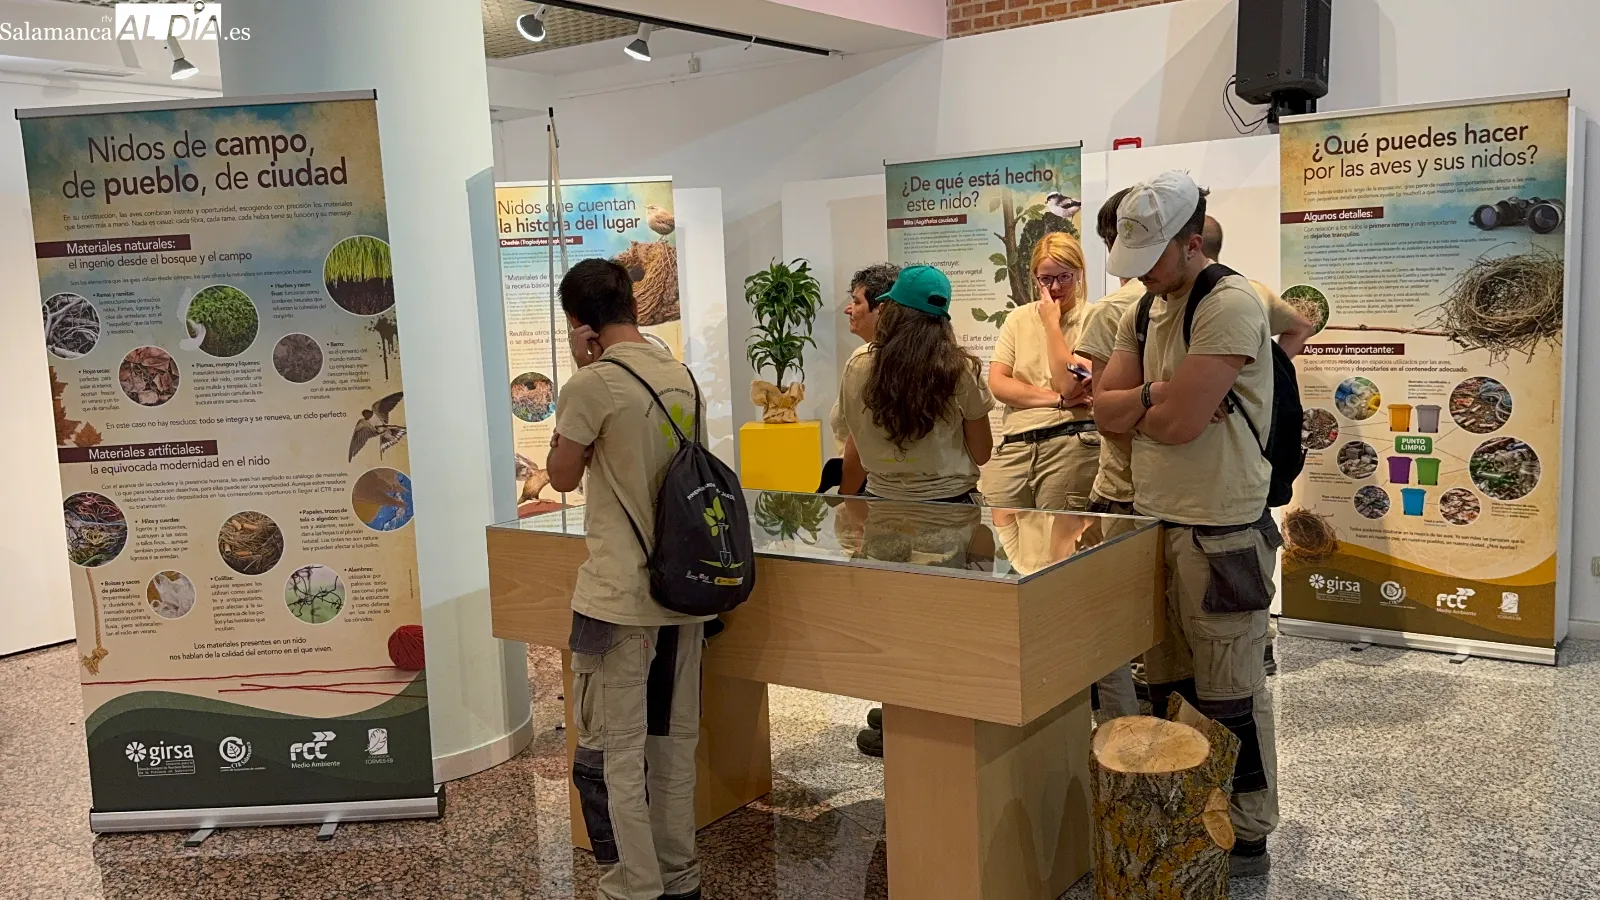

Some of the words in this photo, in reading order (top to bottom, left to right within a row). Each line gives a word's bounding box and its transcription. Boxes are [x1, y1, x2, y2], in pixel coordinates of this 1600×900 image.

[88, 133, 166, 163] Nidos
[174, 130, 206, 158] de
[215, 134, 314, 161] campo,
[1312, 133, 1368, 162] ¿Qué
[1376, 126, 1457, 157] puedes
[1465, 123, 1528, 144] hacer
[1304, 166, 1335, 185] por
[1341, 159, 1364, 177] las
[1370, 159, 1411, 174] aves
[1417, 159, 1428, 178] y
[1434, 156, 1464, 170] sus
[1472, 145, 1538, 168] nidos?
[62, 170, 95, 198] de
[104, 165, 206, 204] pueblo,
[215, 162, 248, 190] de
[258, 156, 347, 188] ciudad
[902, 176, 930, 197] ¿De
[935, 172, 963, 194] qué
[968, 169, 1000, 187] está
[1006, 164, 1053, 185] hecho
[240, 204, 272, 214] escogiendo
[498, 199, 541, 215] Nidos
[578, 198, 636, 211] cuentan
[907, 197, 935, 212] este
[940, 191, 979, 210] nido?
[500, 218, 512, 234] la
[516, 218, 570, 233] histora
[575, 215, 598, 231] del
[603, 214, 640, 233] lugar
[1304, 212, 1336, 223] Algunos
[1339, 210, 1373, 219] detalles:
[1369, 222, 1390, 230] primera
[1310, 231, 1330, 240] dejarlos
[66, 240, 122, 255] Materiales
[124, 238, 176, 252] naturales:
[69, 258, 77, 269] el
[80, 256, 114, 272] ingenio
[118, 255, 147, 266] desde
[151, 254, 158, 265] el
[161, 253, 197, 267] bosque
[200, 255, 206, 266] y
[208, 251, 216, 262] el
[219, 252, 252, 264] campo
[1304, 345, 1323, 355] Algo
[1345, 345, 1394, 355] importante:
[158, 419, 168, 429] hay
[200, 417, 214, 425] todo
[226, 416, 248, 425] integra
[88, 446, 145, 460] Materiales
[148, 444, 204, 457] artificiales:
[91, 464, 98, 474] la
[101, 460, 157, 476] equivocada
[160, 457, 219, 470] modernidad
[222, 459, 234, 467] en
[237, 455, 245, 466] el
[248, 454, 270, 466] nido
[1326, 576, 1360, 593] girsa
[207, 640, 239, 649] materiales
[241, 638, 271, 649] presentes
[292, 636, 306, 644] nido
[182, 651, 203, 660] hablan
[222, 649, 244, 657] calidad
[246, 648, 255, 656] del
[257, 647, 282, 655] entorno
[294, 645, 299, 653] el
[301, 647, 312, 655] que
[150, 741, 194, 766] girsa
